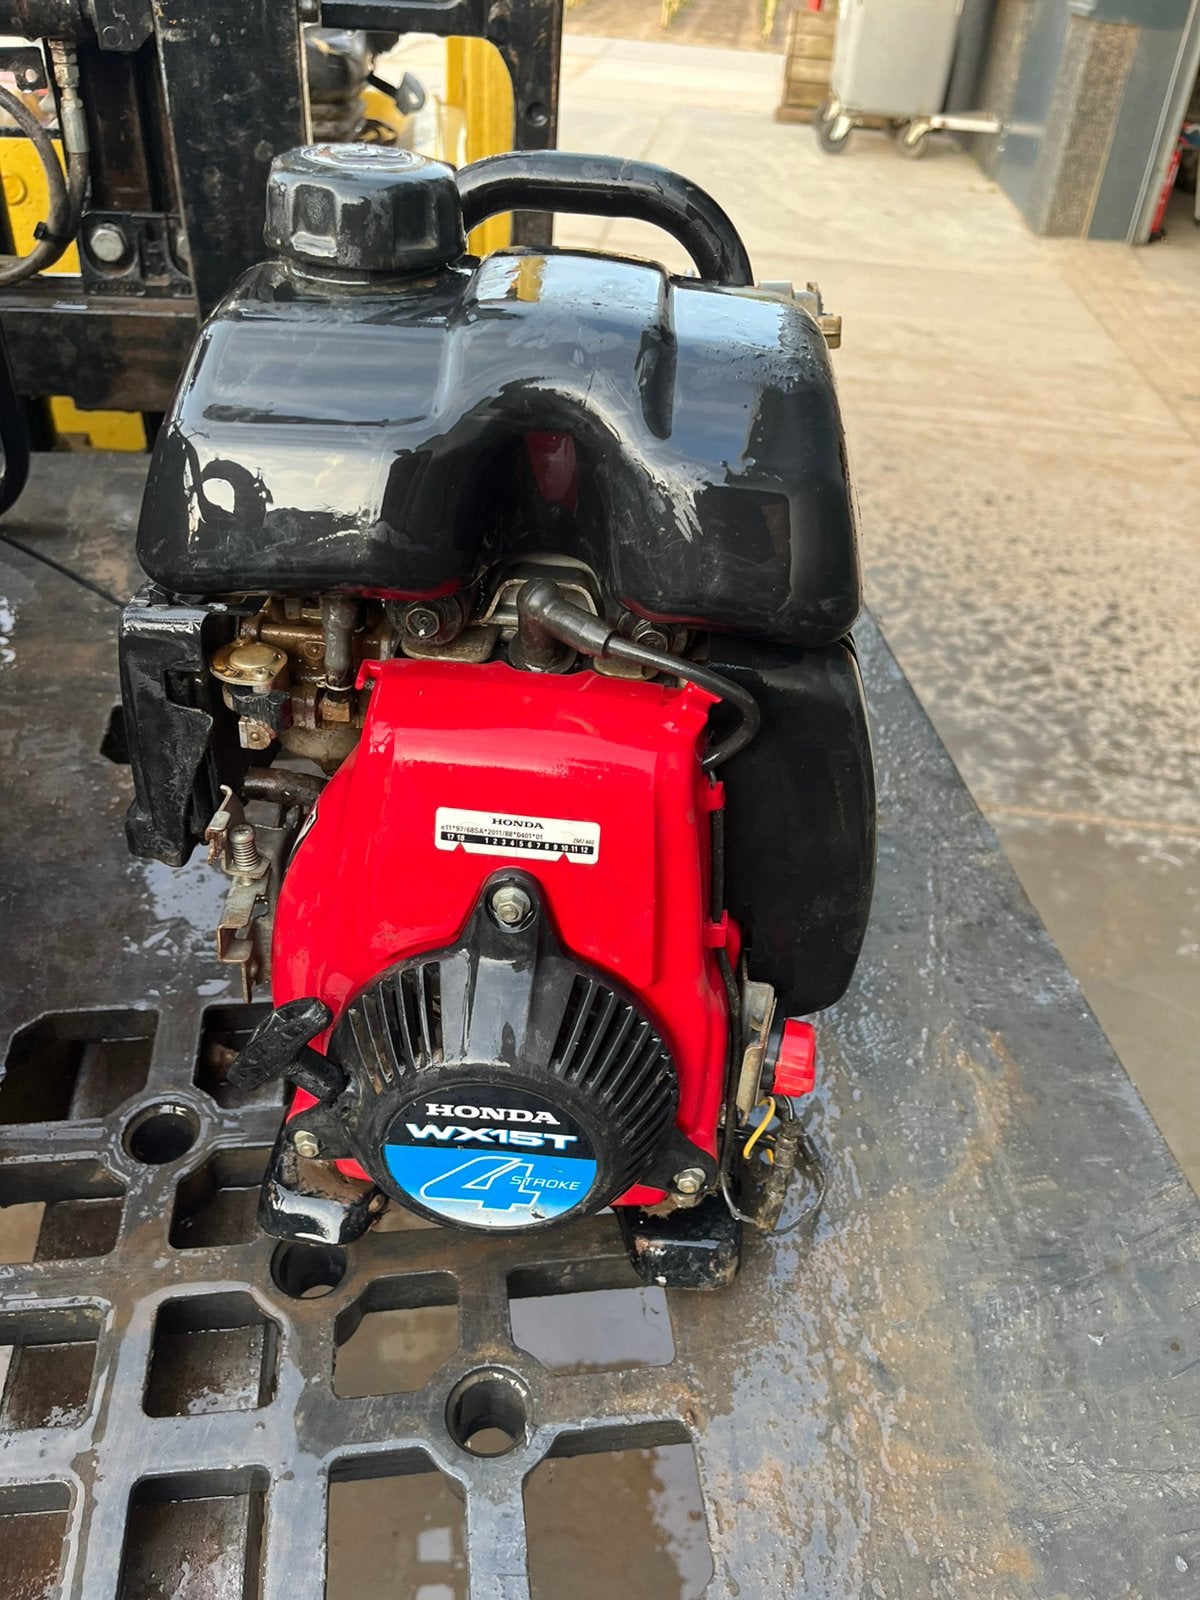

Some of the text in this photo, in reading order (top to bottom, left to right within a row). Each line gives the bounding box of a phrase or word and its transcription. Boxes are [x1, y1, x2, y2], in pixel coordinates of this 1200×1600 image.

[492, 818, 544, 829] HONDA
[425, 1103, 561, 1125] HONDA
[405, 1122, 578, 1150] WX15T
[420, 1155, 581, 1212] 4 STROKE
